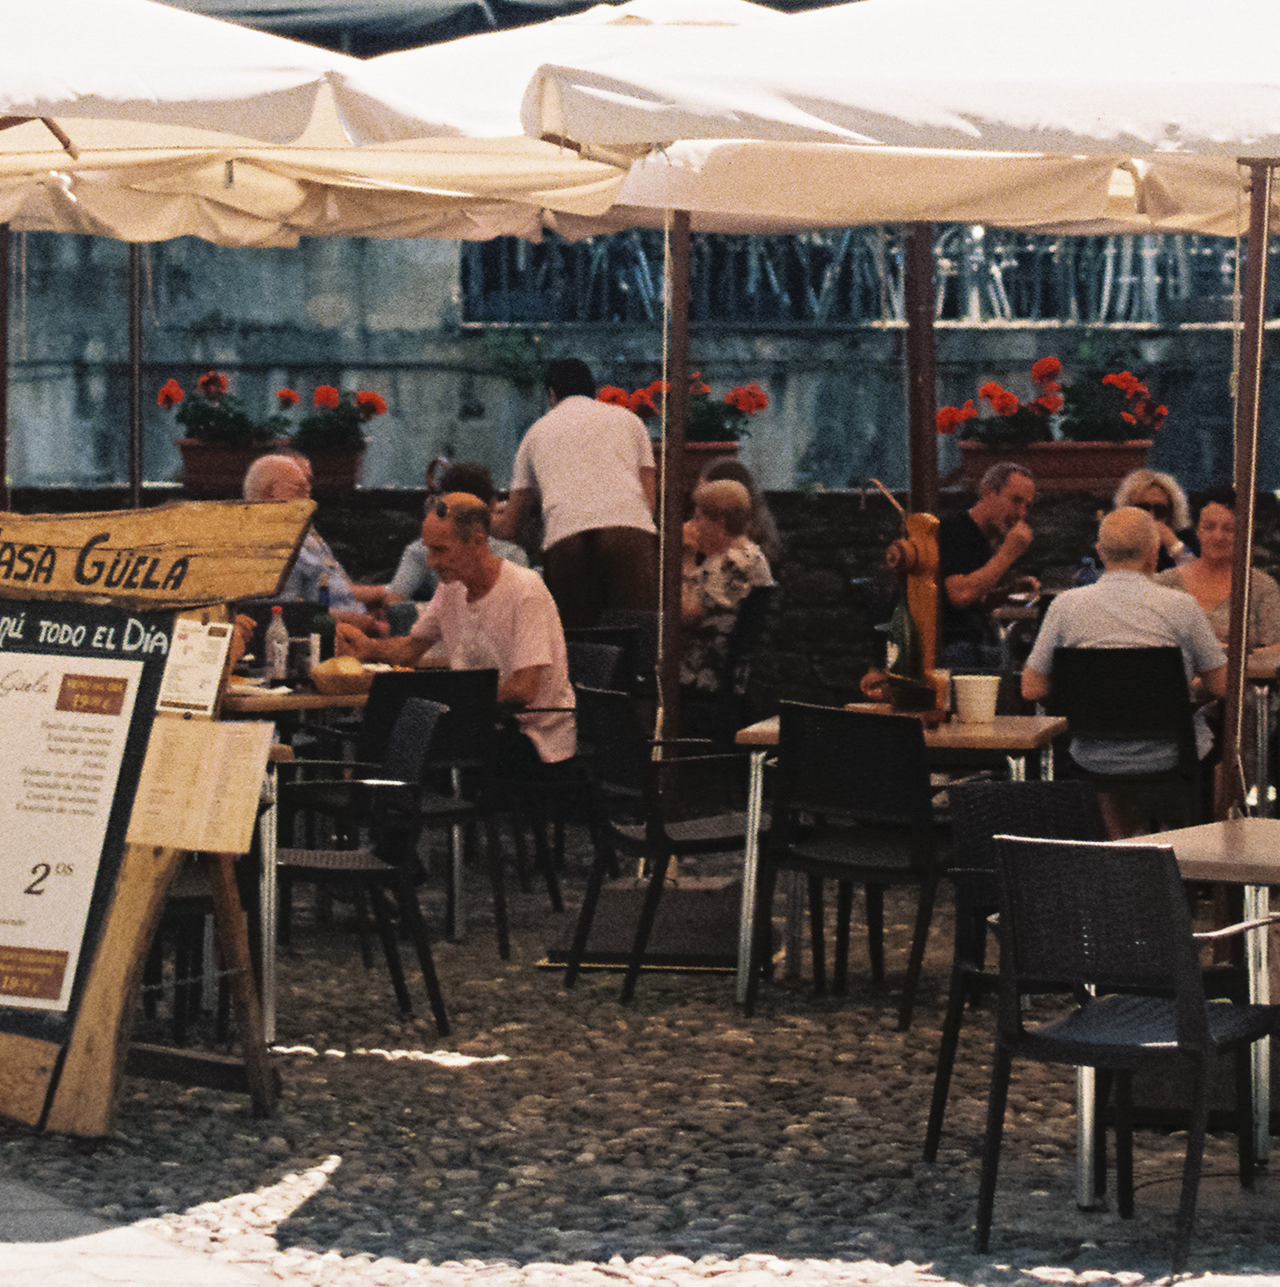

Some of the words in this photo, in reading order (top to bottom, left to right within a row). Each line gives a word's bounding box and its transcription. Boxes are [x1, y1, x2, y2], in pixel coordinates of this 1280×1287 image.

[74, 532, 190, 591] GÜELA
[38, 620, 86, 648] TODO
[91, 625, 116, 651] EL
